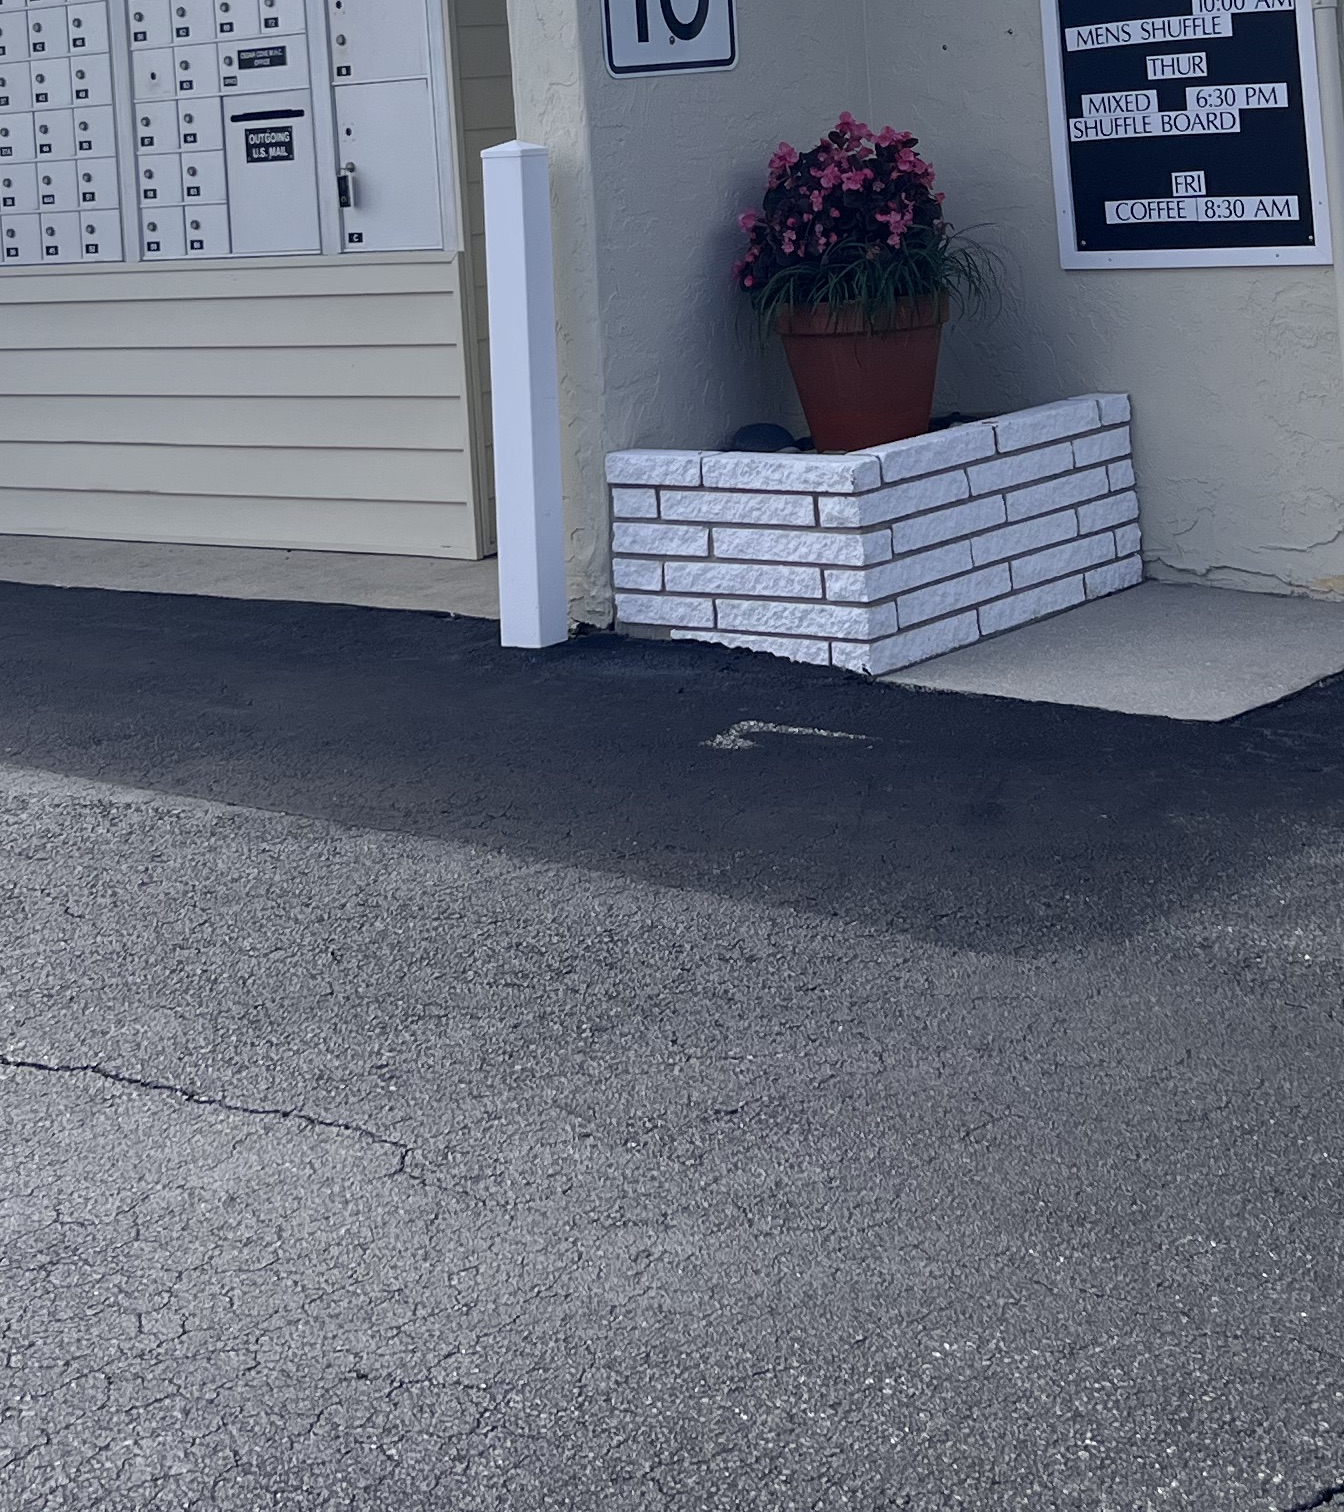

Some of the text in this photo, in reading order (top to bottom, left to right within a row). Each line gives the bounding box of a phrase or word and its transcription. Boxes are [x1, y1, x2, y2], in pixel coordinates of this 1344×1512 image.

[1076, 16, 1222, 47] MENS SHUFFLE
[1148, 57, 1205, 76] THUR
[1088, 87, 1278, 114] MIXED 6:30 PM
[1073, 112, 1236, 139] SHUFFLE BOARD
[249, 132, 290, 144] OUTGOING
[253, 147, 288, 158] U.S. MAIL
[1174, 175, 1202, 193] FRI
[1115, 199, 1291, 220] COFFEE 8:30 AM
